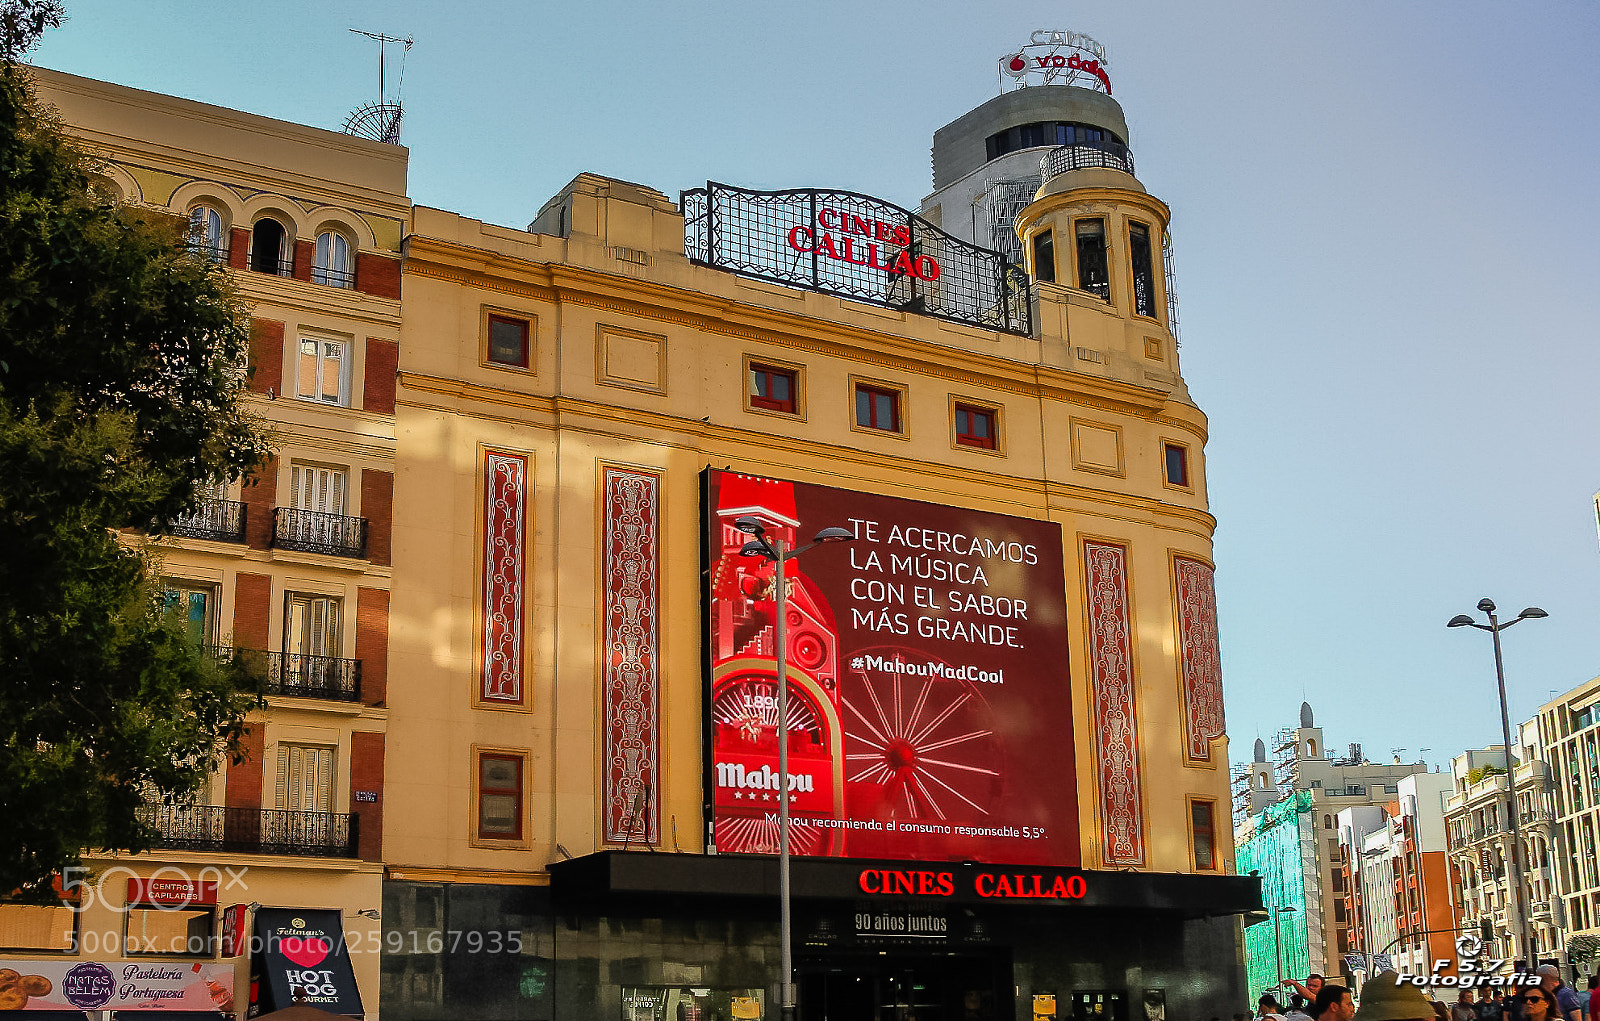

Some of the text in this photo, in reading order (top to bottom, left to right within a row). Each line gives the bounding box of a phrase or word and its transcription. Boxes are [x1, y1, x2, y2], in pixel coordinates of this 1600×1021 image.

[818, 208, 910, 247] CINES
[788, 226, 941, 282] CALLAO
[848, 517, 1038, 566] TE ACERCAMOS
[850, 547, 989, 587] LA MÚSICA
[851, 578, 1028, 621] CON EL SABOR
[851, 606, 1024, 649] MÁS GRANDE.
[850, 654, 1004, 684] #MahouMadCool
[715, 762, 814, 793] Mahou
[812, 817, 883, 831] recomienda
[886, 818, 896, 832] el
[899, 822, 951, 835] consumo
[954, 823, 1020, 838] responsable
[148, 891, 199, 900] CAPILARES
[152, 883, 195, 892] CENTROS
[859, 869, 1087, 899] CINES CALLAO
[855, 912, 947, 932] 90 años juntos
[123, 964, 183, 981] Pastelería
[285, 969, 334, 984] HOT
[119, 983, 185, 1001] Portuguesa
